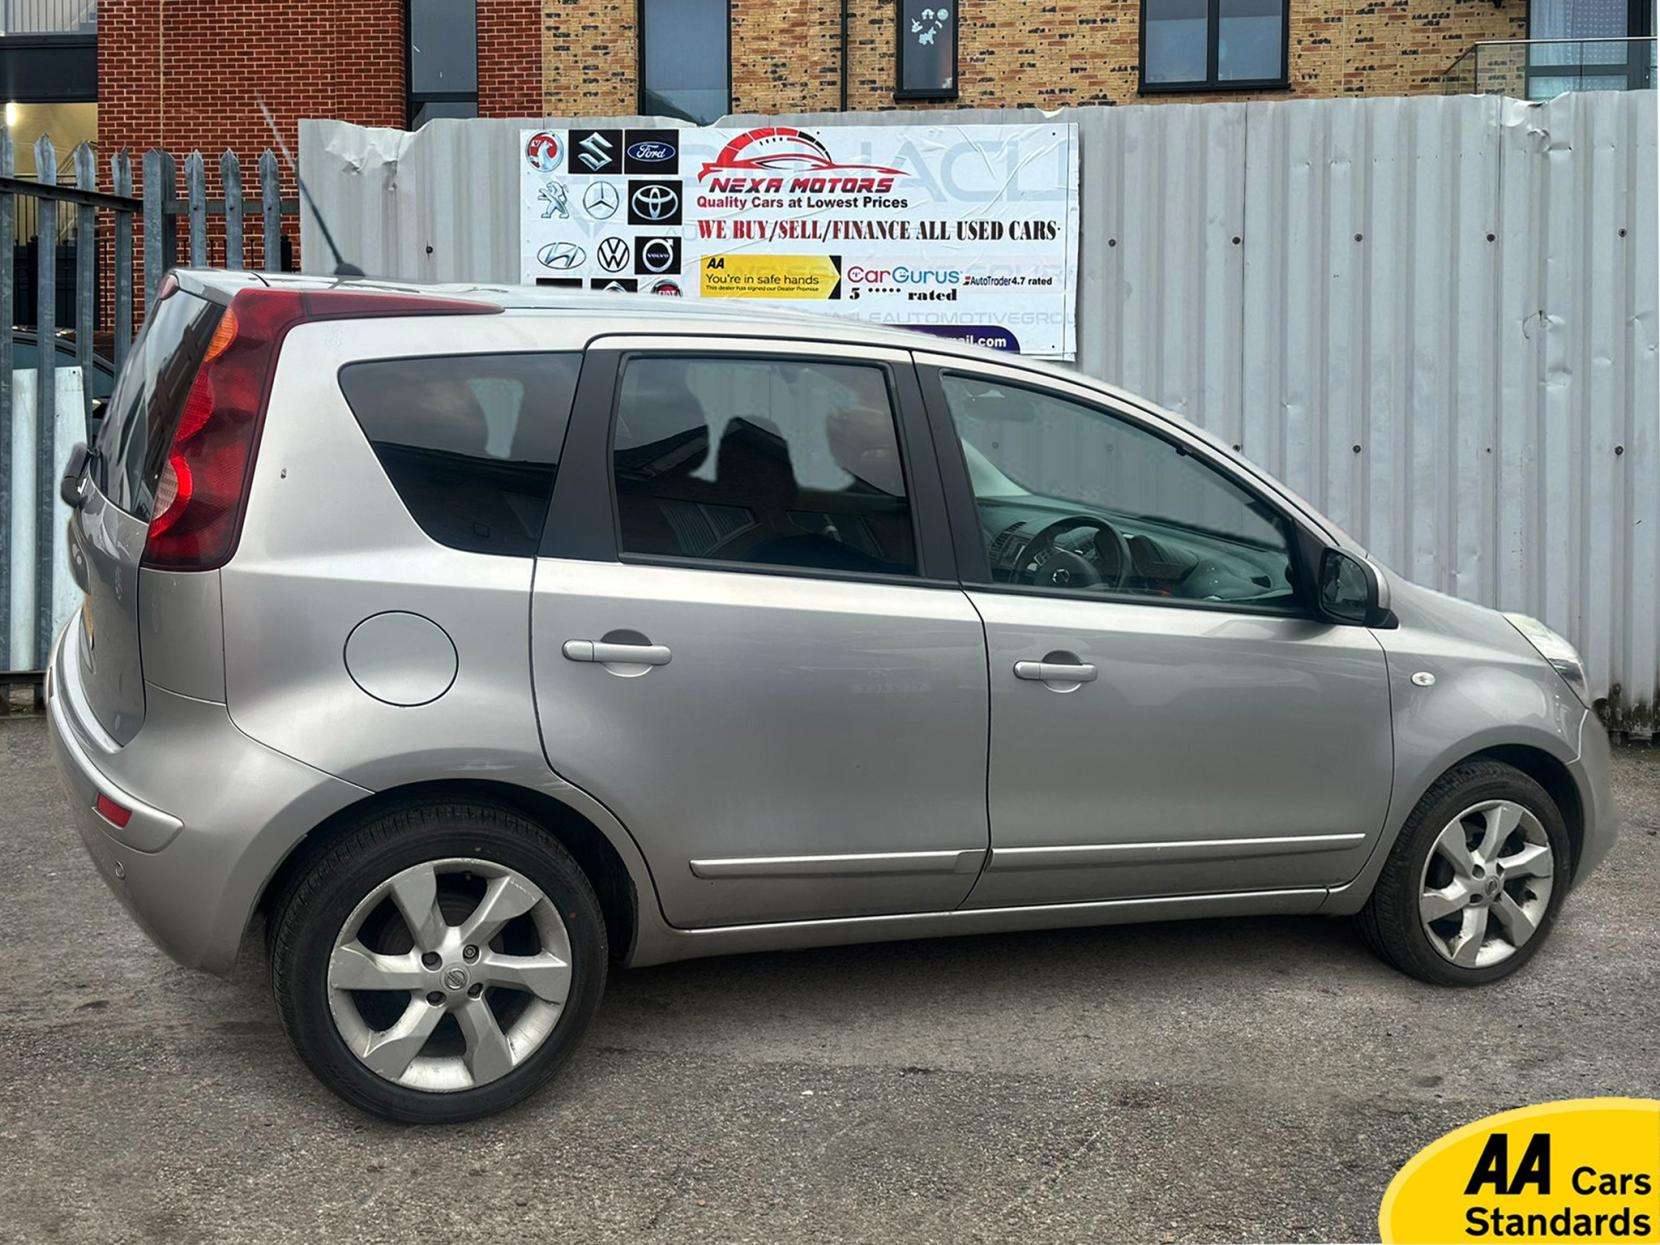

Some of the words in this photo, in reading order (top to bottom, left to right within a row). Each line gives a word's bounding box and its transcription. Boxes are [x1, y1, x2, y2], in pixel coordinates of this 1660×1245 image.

[636, 144, 666, 159] Ford
[709, 177, 783, 194] NEXA
[789, 177, 895, 194] MOTORS
[697, 195, 748, 211] Quality
[752, 196, 784, 209] Cars
[788, 196, 802, 209] at
[807, 195, 859, 209] Lowest
[863, 195, 909, 209] Prices
[697, 219, 727, 240] WE
[916, 220, 951, 241] ALL
[956, 220, 1004, 241] USED
[1008, 220, 1057, 241] CARS
[706, 257, 725, 270] AA
[706, 273, 741, 285] You're
[744, 274, 754, 285] in
[757, 274, 781, 285] safe
[784, 274, 820, 285] hands
[847, 266, 960, 284] CarGurus
[1028, 276, 1053, 286] rated
[849, 286, 861, 300] 5
[908, 287, 957, 302] rated
